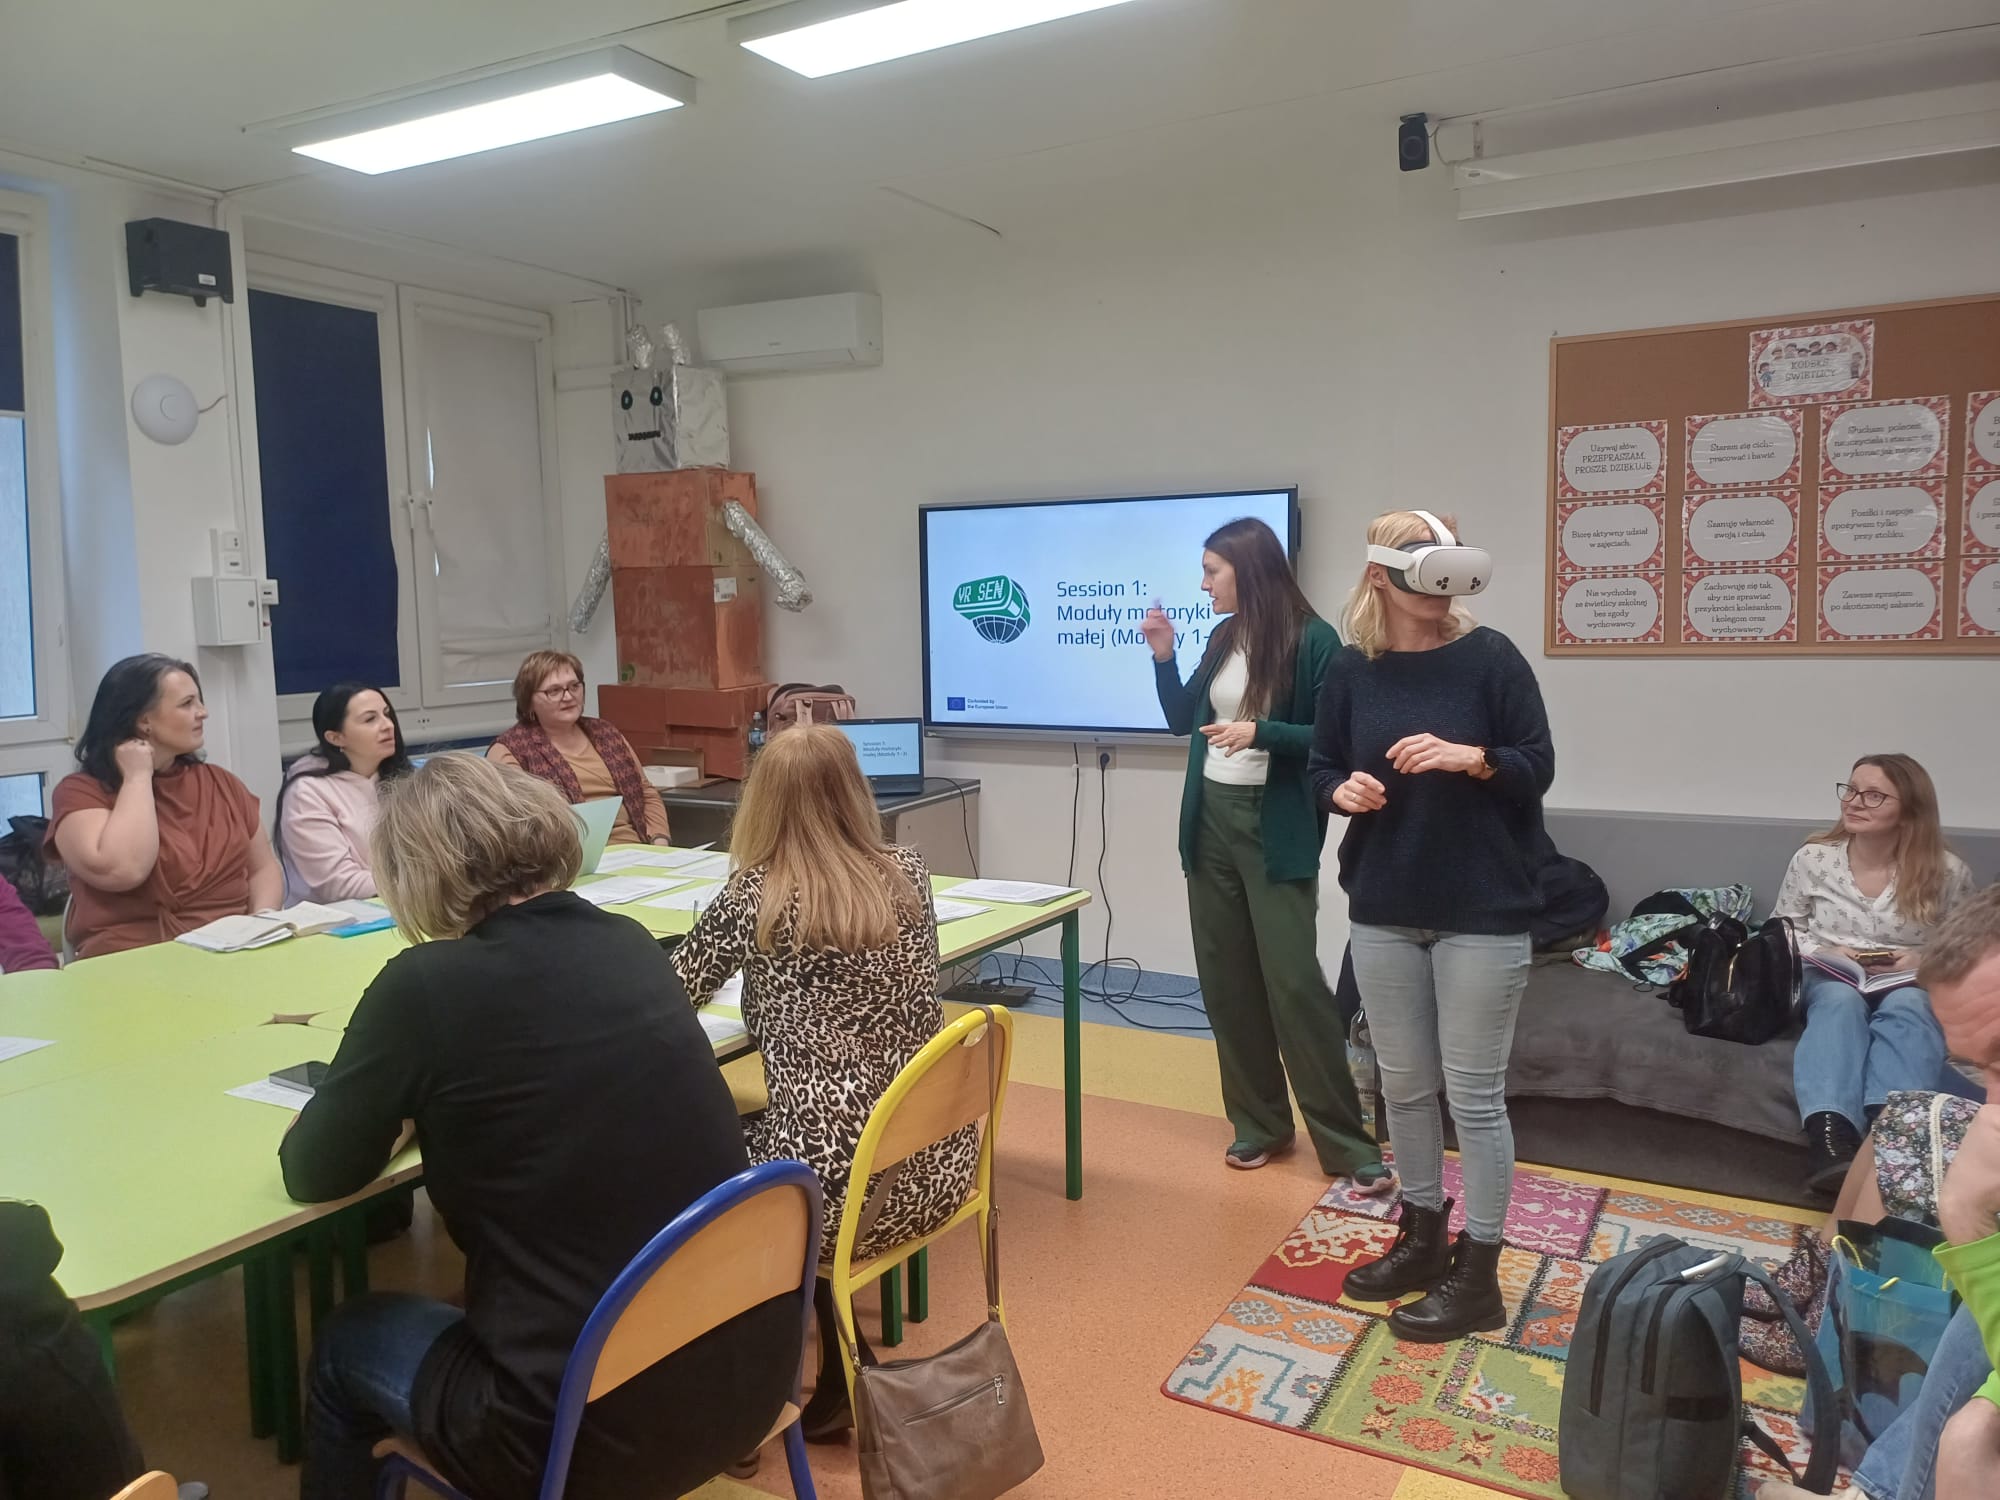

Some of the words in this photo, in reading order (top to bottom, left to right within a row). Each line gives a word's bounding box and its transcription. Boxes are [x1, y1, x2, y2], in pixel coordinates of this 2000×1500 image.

[1593, 529, 1624, 538] aktywny
[958, 585, 972, 603] VR
[977, 579, 1005, 601] SEN
[1057, 581, 1125, 598] Session
[1132, 580, 1147, 596] 1:
[1586, 589, 1599, 597] Nie
[1707, 593, 1721, 602] aby
[1057, 604, 1122, 625] Moduły
[1594, 610, 1606, 618] bez
[1608, 609, 1630, 618] zgody
[1715, 615, 1747, 624] kolegom
[1058, 628, 1105, 649] małej
[1111, 628, 1185, 649] (Moy
